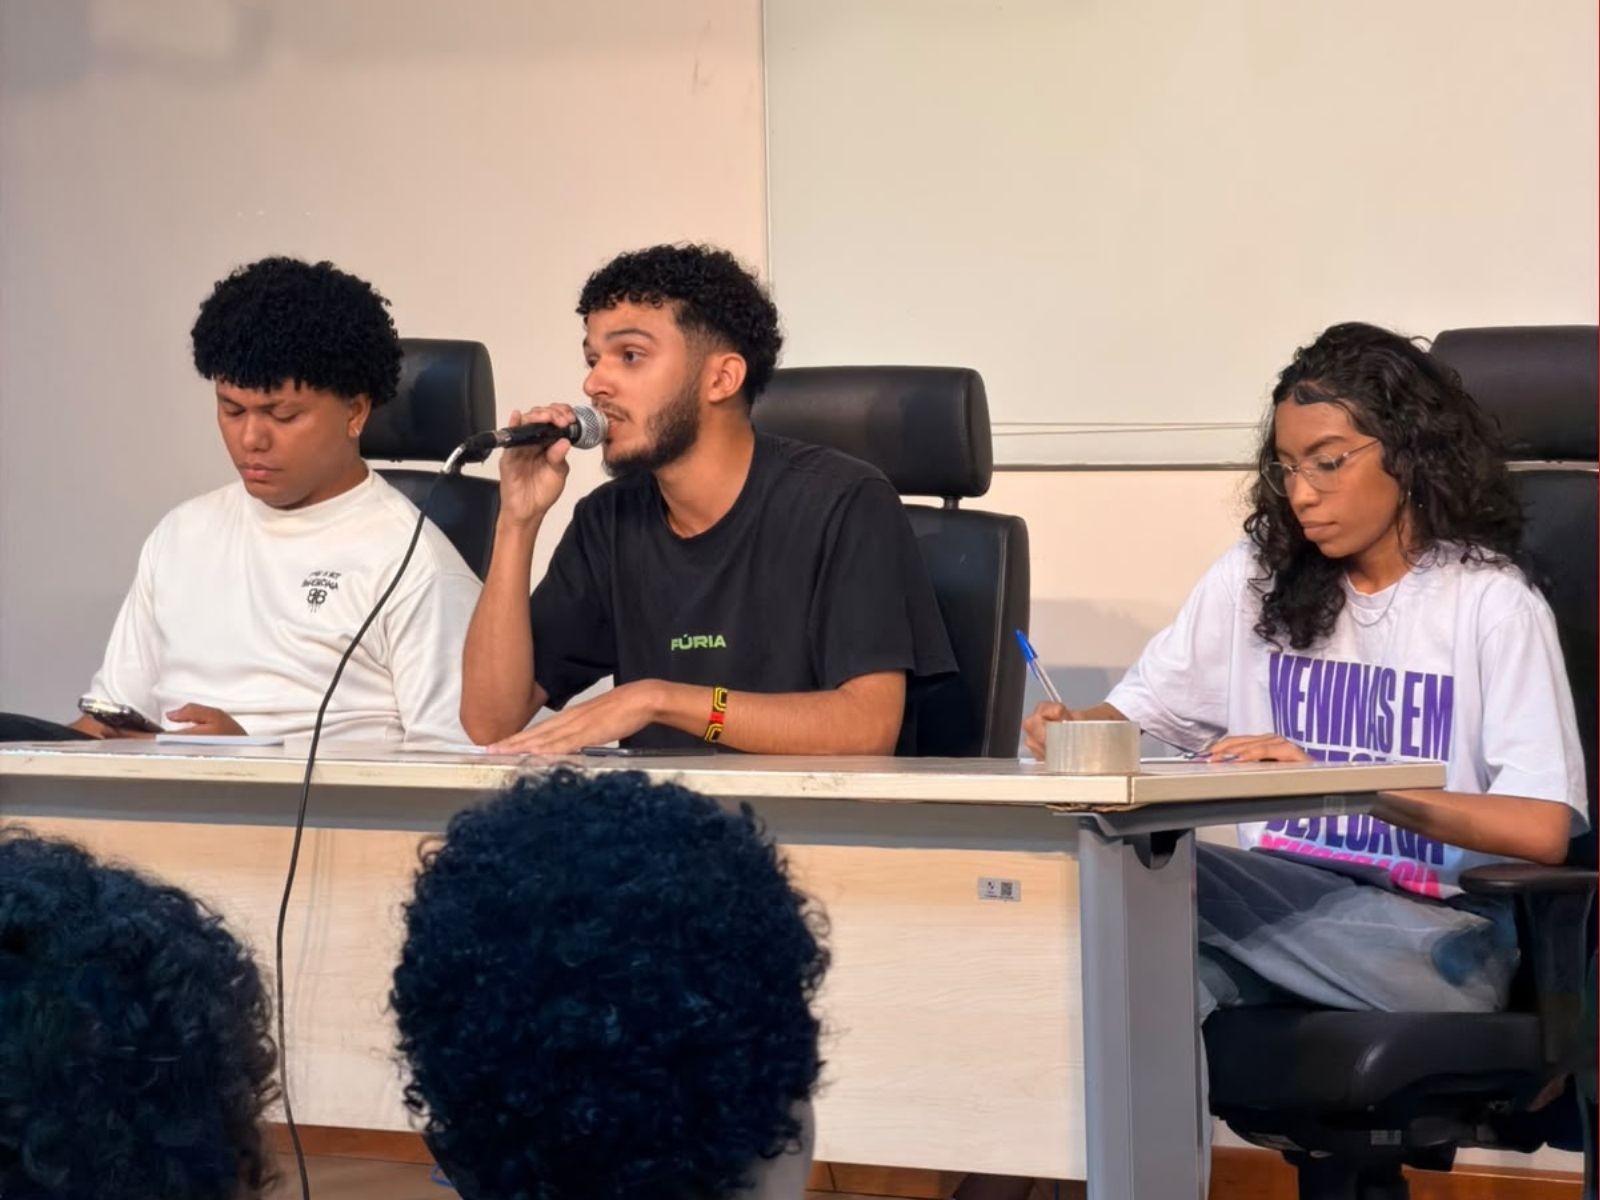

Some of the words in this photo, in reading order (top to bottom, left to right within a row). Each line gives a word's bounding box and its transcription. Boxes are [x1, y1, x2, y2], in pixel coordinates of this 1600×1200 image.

[671, 633, 727, 651] FÚRIA
[1269, 652, 1397, 754] MENINAS
[1400, 671, 1455, 761] EM
